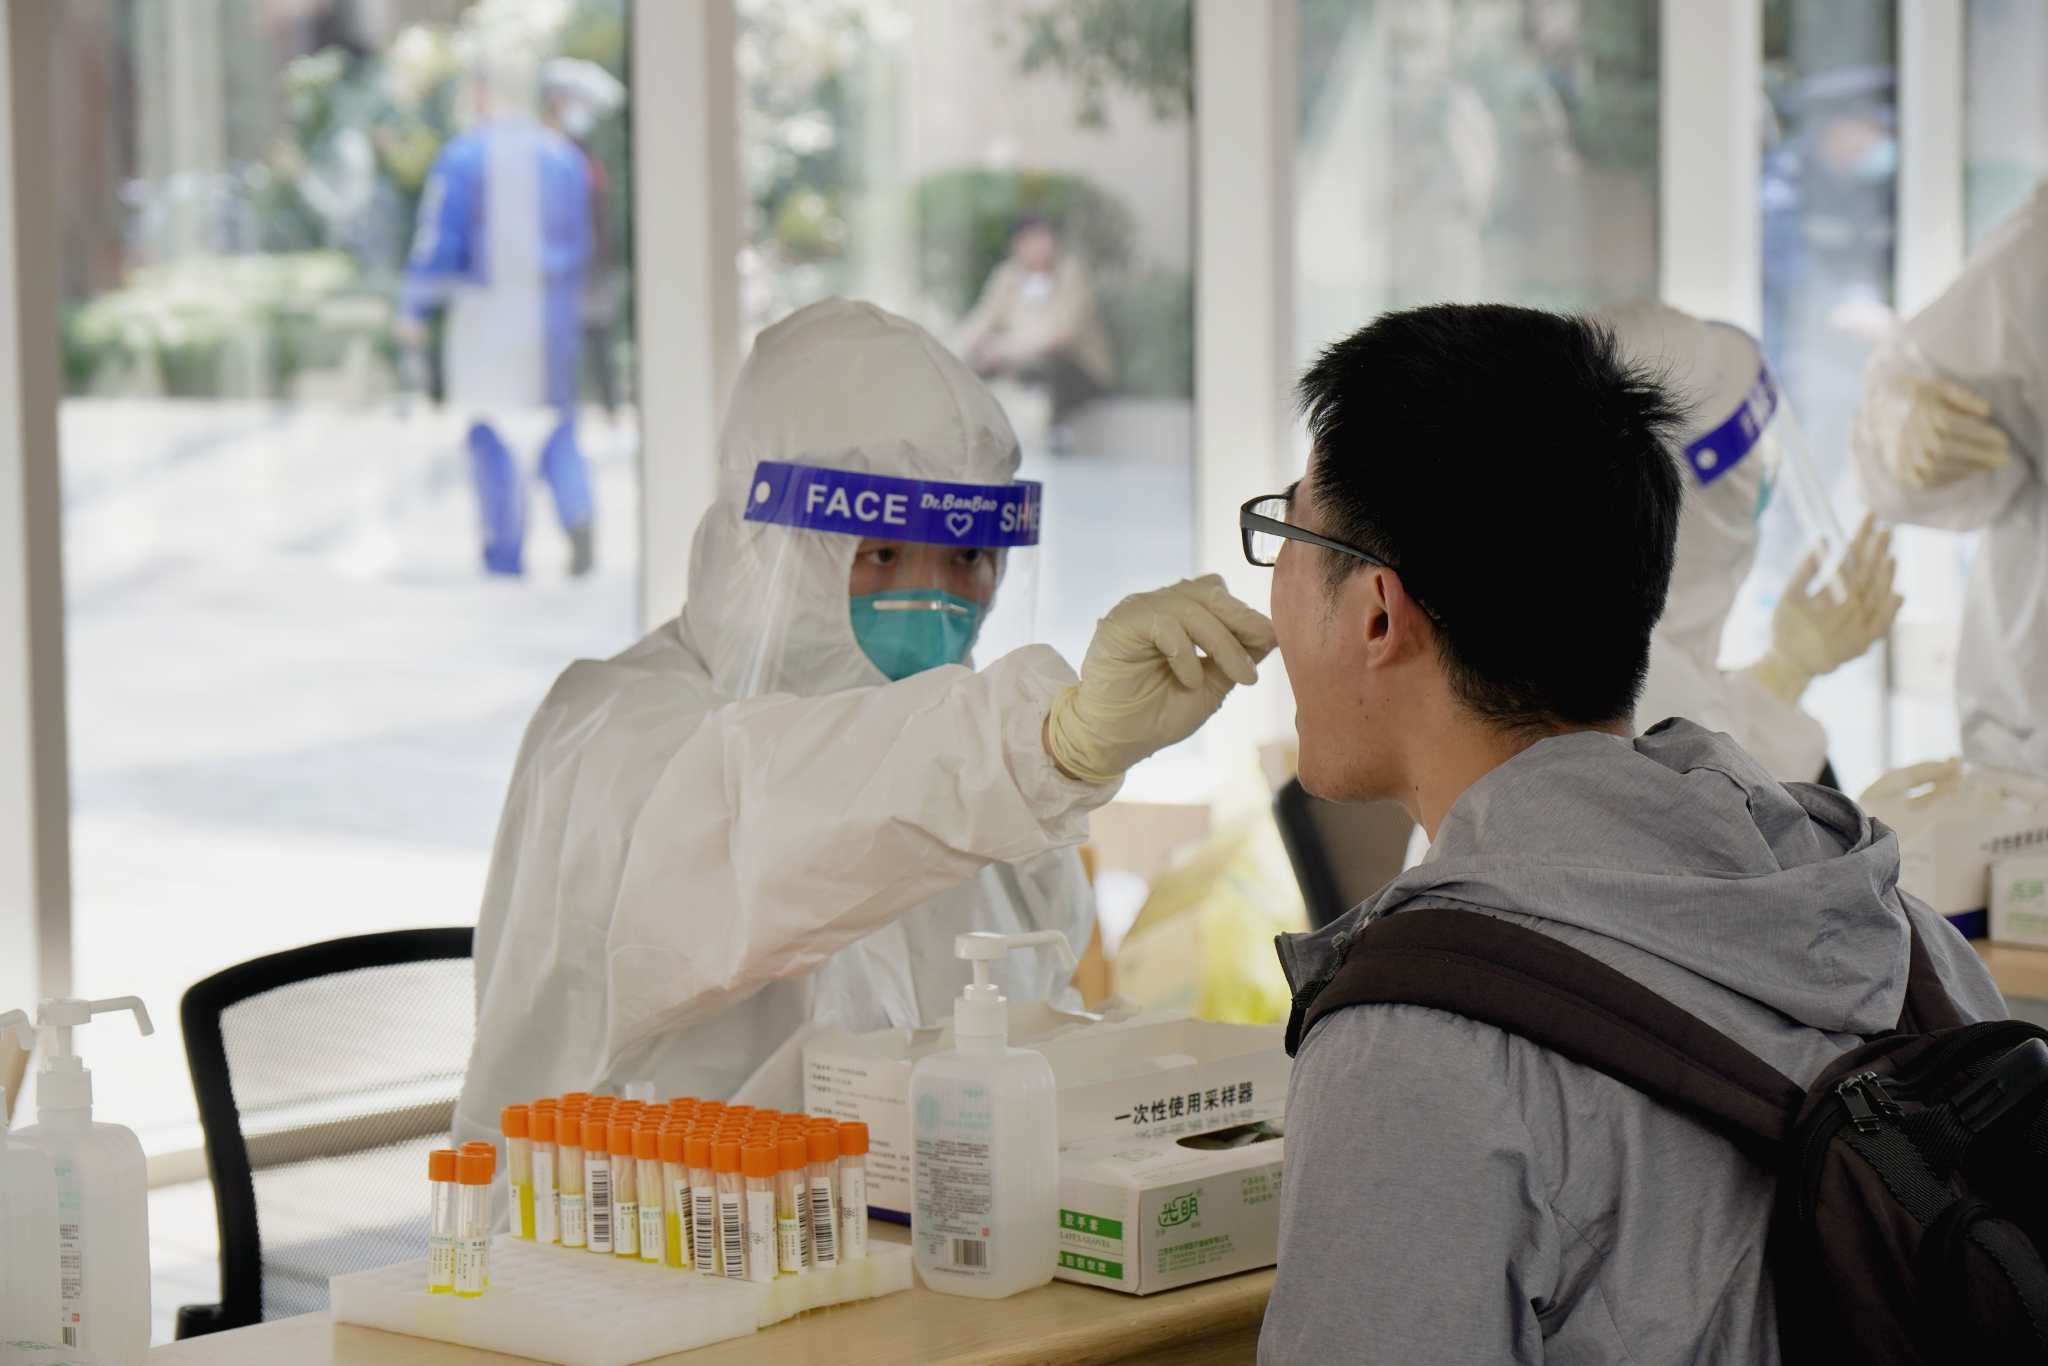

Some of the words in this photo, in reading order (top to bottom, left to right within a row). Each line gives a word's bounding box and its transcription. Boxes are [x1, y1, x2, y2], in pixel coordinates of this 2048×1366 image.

[806, 483, 908, 525] FACE
[1115, 1081, 1253, 1125] 一次性使用采样器
[1159, 1195, 1198, 1225] 光明
[1082, 1235, 1111, 1248] GLOVES
